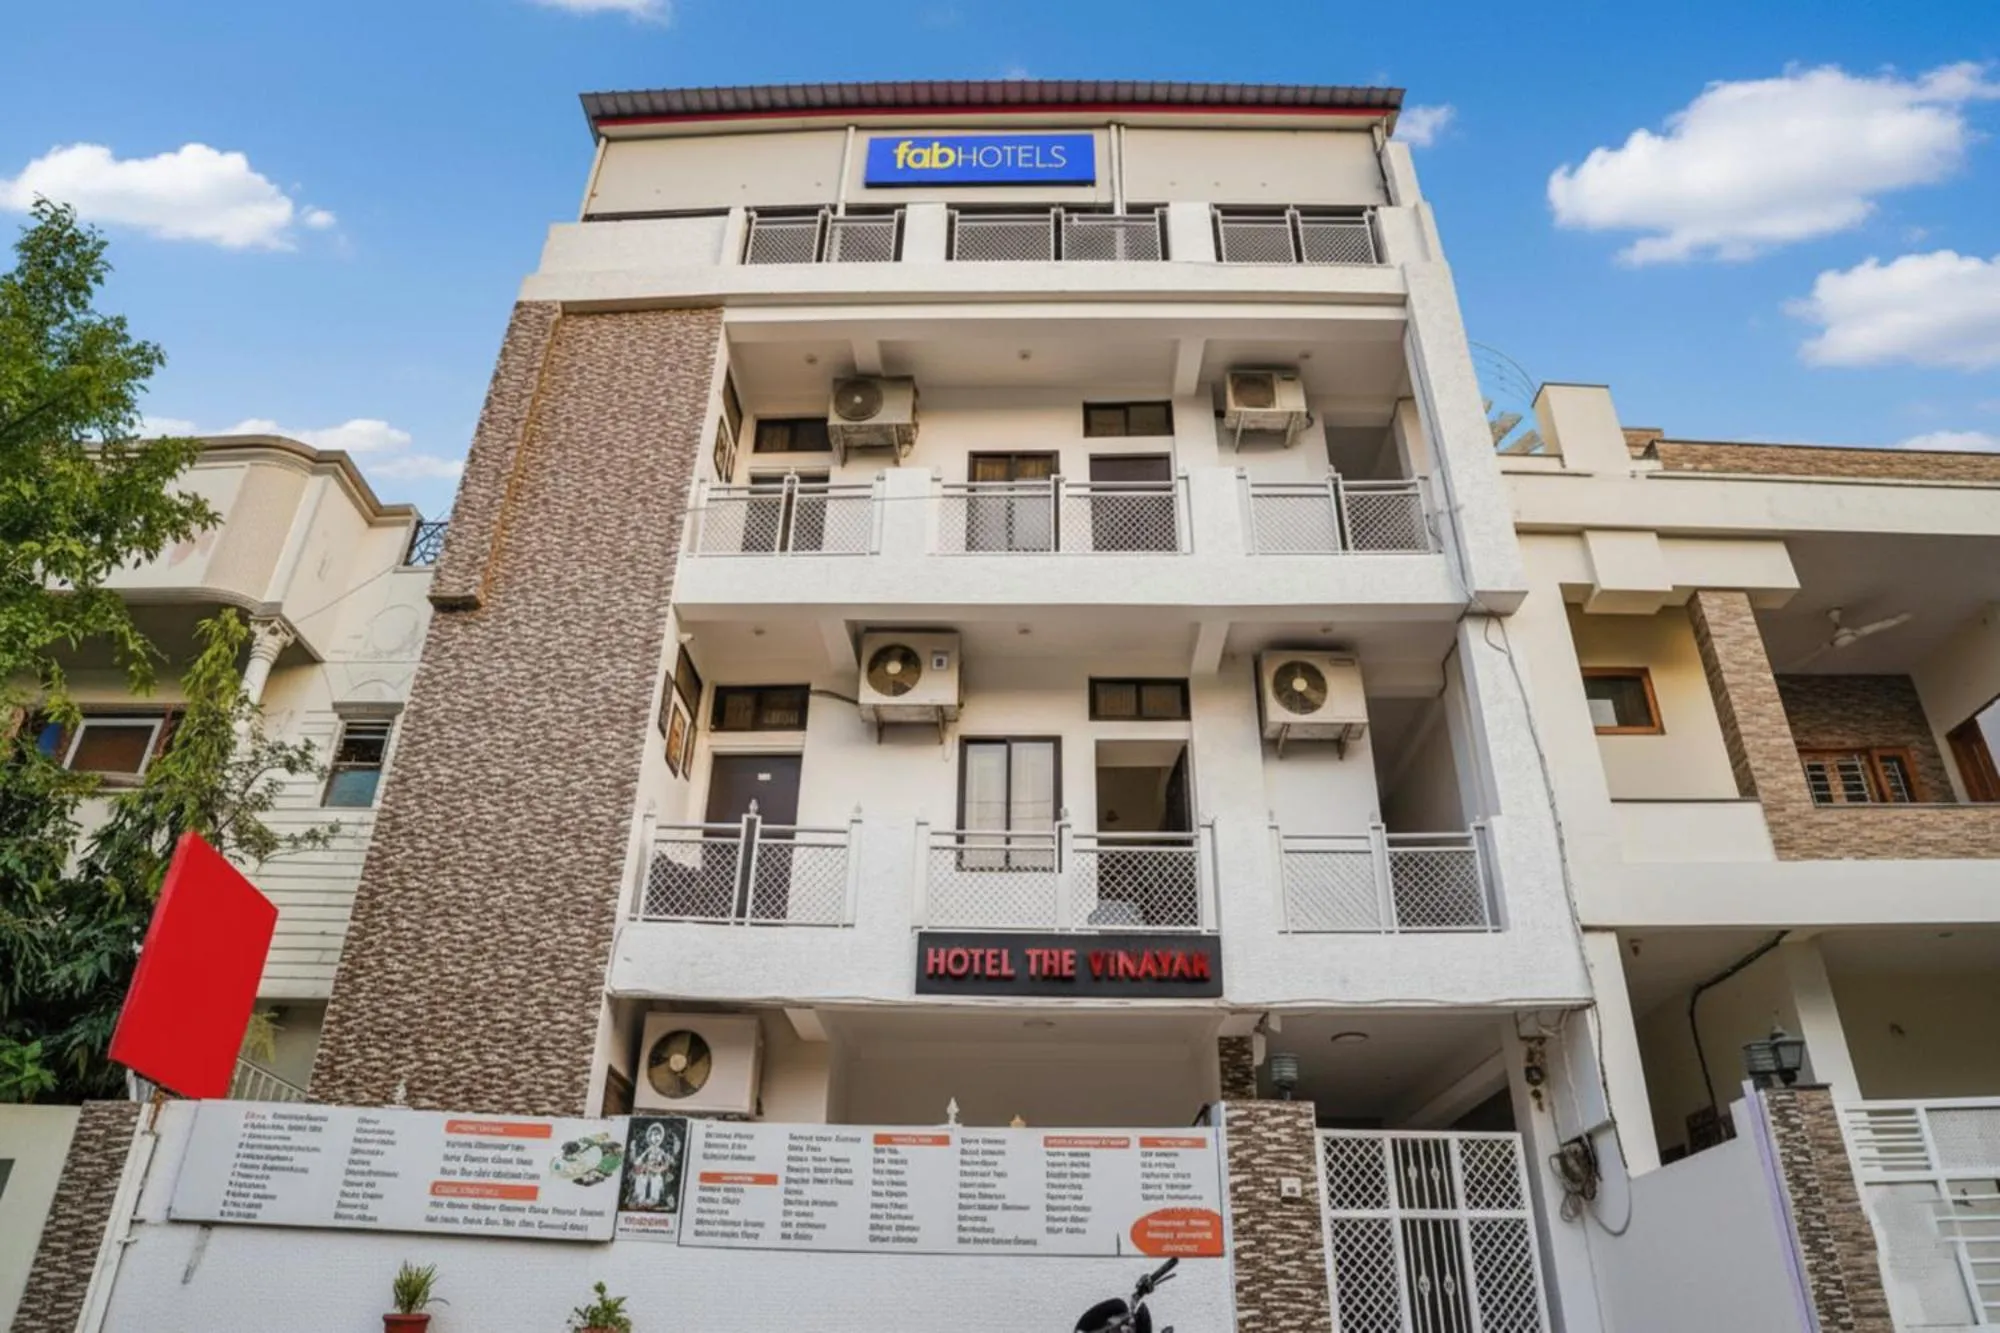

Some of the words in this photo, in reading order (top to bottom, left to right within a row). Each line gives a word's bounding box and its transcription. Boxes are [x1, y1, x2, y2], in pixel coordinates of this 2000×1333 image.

[893, 140, 1067, 169] fabHOTELS
[926, 947, 1015, 977] HOTEL
[1025, 949, 1077, 978] THE
